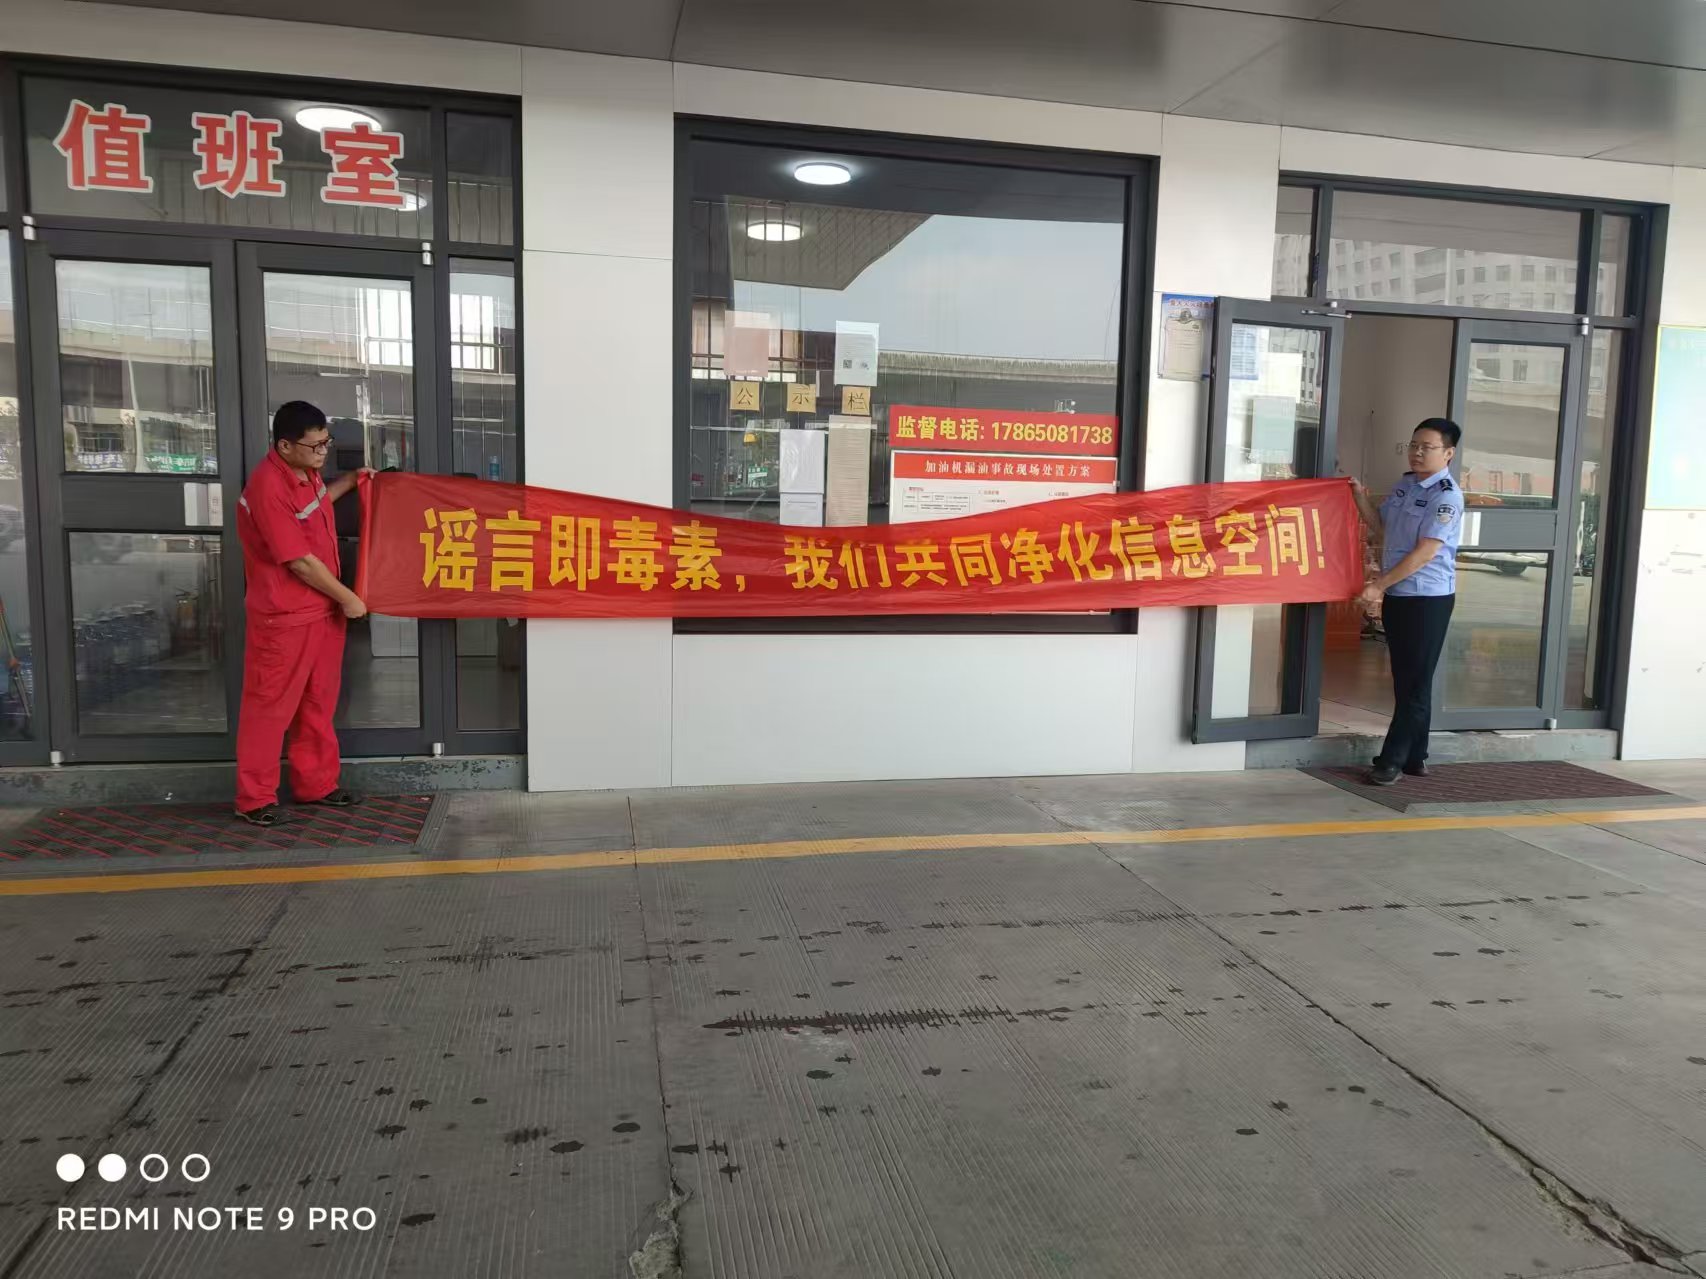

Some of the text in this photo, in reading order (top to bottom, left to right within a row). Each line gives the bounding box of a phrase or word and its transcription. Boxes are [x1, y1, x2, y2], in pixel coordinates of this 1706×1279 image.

[53, 99, 407, 208] 值班室
[895, 415, 1113, 445] 监督电话: 17865081738
[924, 459, 1091, 478] 加油机漏油事故现场处置方案
